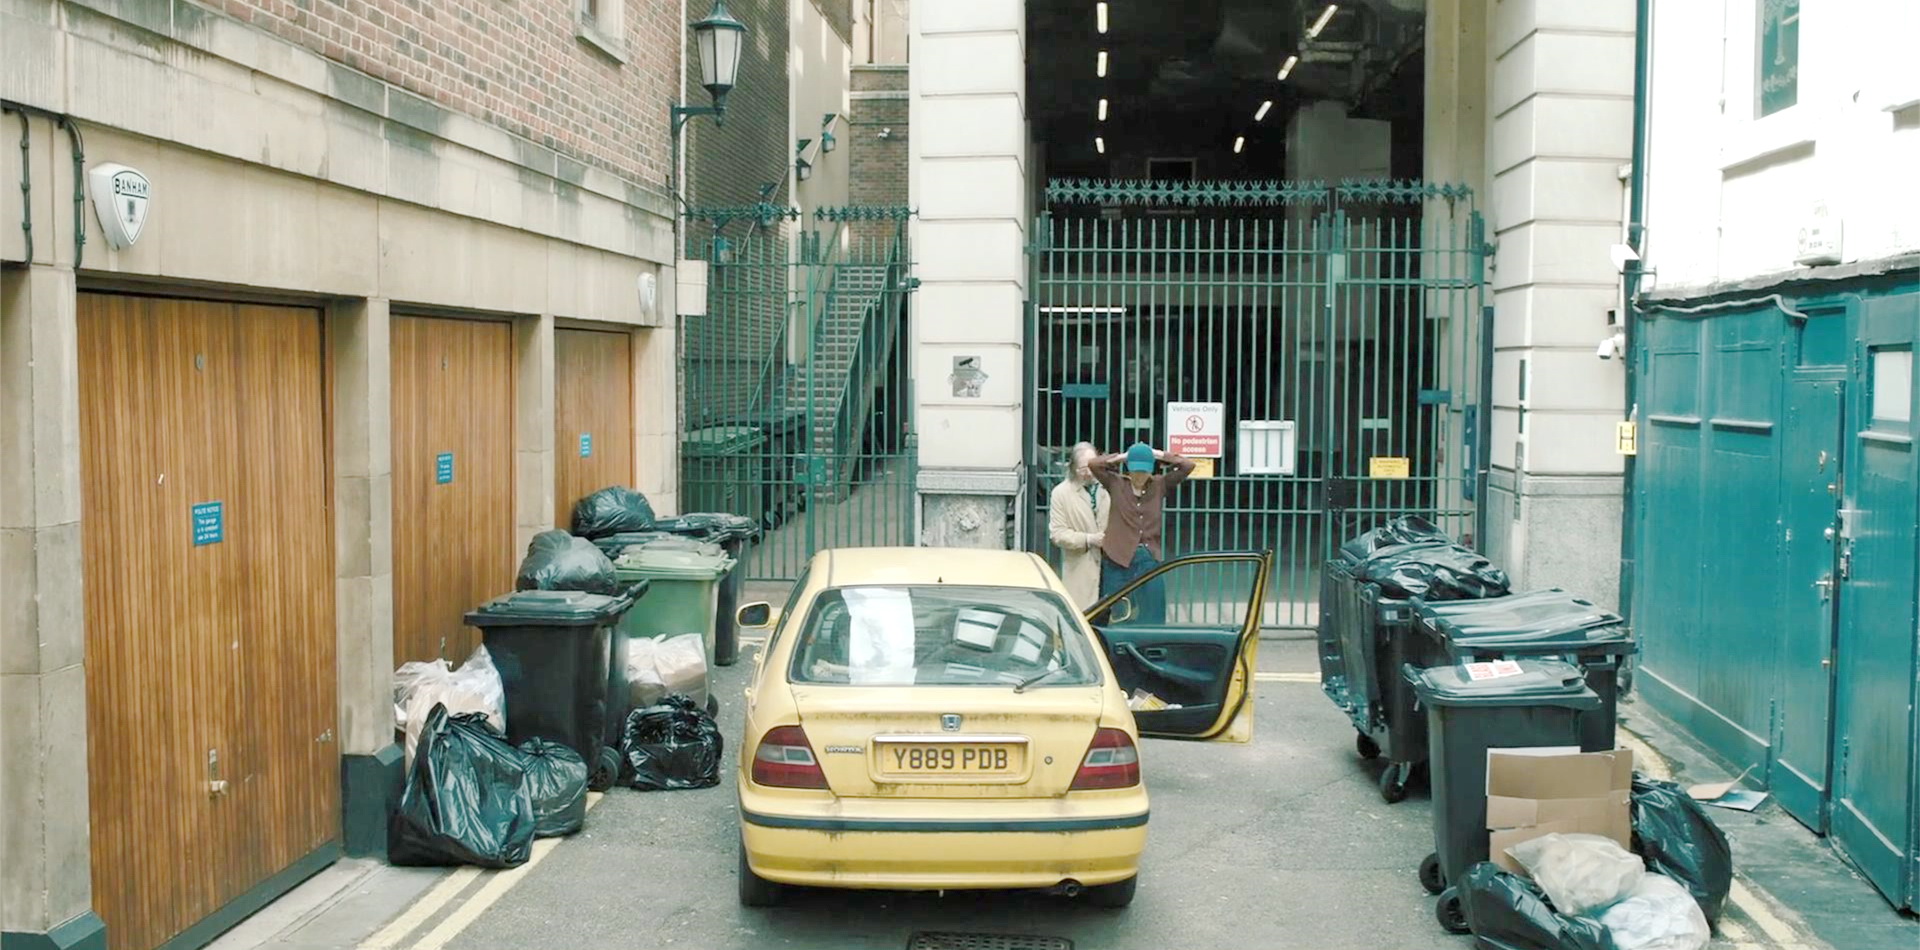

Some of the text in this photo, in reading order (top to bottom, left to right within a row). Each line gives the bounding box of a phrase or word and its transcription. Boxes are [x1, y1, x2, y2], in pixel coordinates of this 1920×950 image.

[114, 178, 148, 195] BANHAM
[1202, 405, 1218, 413] Only
[1182, 437, 1218, 446] pedestrian
[893, 748, 1008, 770] Y889 PDB
